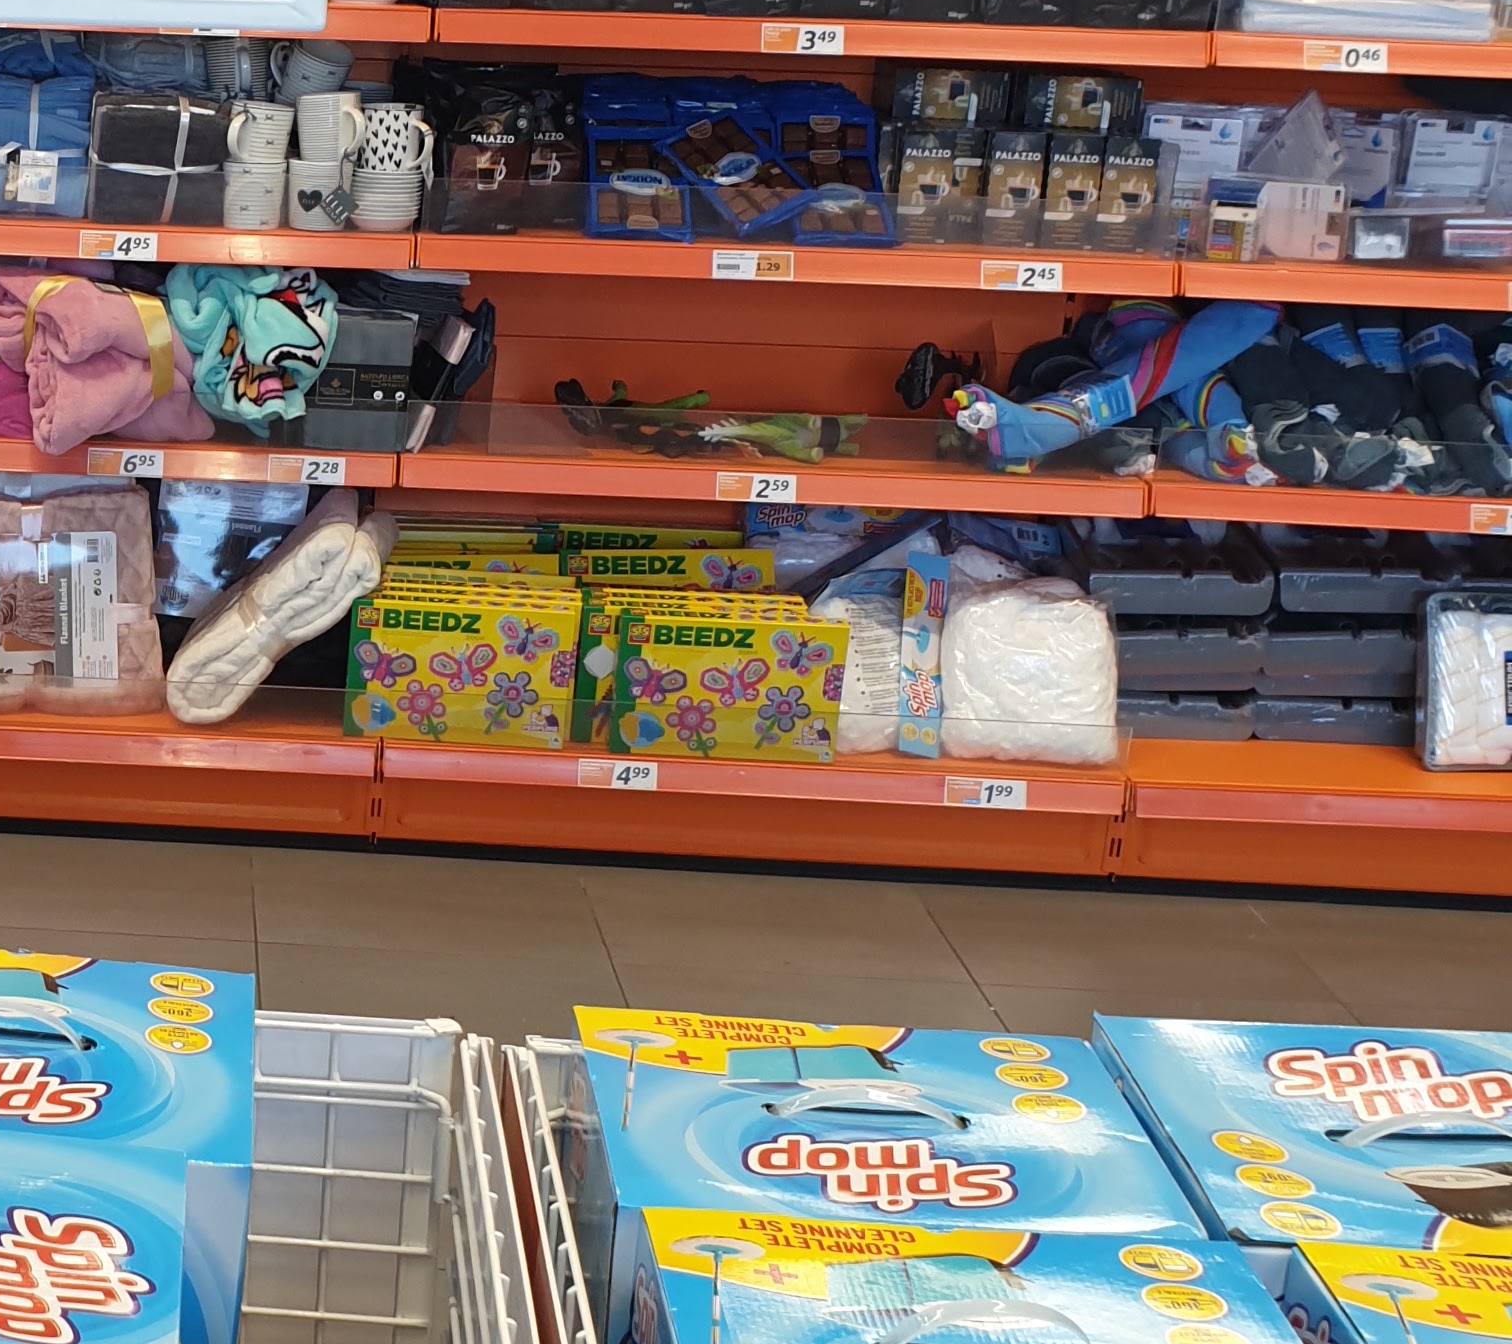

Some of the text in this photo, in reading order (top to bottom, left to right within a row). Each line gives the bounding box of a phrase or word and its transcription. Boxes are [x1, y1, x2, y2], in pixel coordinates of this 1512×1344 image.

[911, 72, 925, 116] PALAZZO
[1045, 78, 1057, 123] PALAZZO
[470, 133, 515, 144] PALAZZO
[906, 148, 951, 158] PALAZZO
[995, 150, 1041, 161] PALAZZO
[1053, 154, 1100, 164] PALAZZO
[1108, 156, 1155, 167] PALAZZO
[756, 262, 780, 272] 1.29
[759, 505, 792, 520] Spin
[771, 512, 806, 528] mop
[567, 531, 657, 549] BEEDZ
[592, 556, 686, 575] BEEDZ
[382, 608, 481, 634] BEEDZ
[654, 625, 755, 649] BEEDZ
[904, 681, 928, 716] Spin
[915, 670, 938, 707] mop
[654, 1015, 805, 1036] CLEANING SET
[674, 1027, 791, 1045] COMPLETE
[1276, 1047, 1432, 1097] Spin
[1359, 1076, 1512, 1117] mop
[757, 1138, 921, 1173] mop
[839, 1163, 1004, 1207] Spin
[739, 1217, 916, 1243] CLEANING SET
[766, 1234, 899, 1256] COMPLETE
[16, 1213, 148, 1314] Spin
[1398, 1254, 1512, 1280] NING SET
[1437, 1272, 1512, 1296] PLETE
